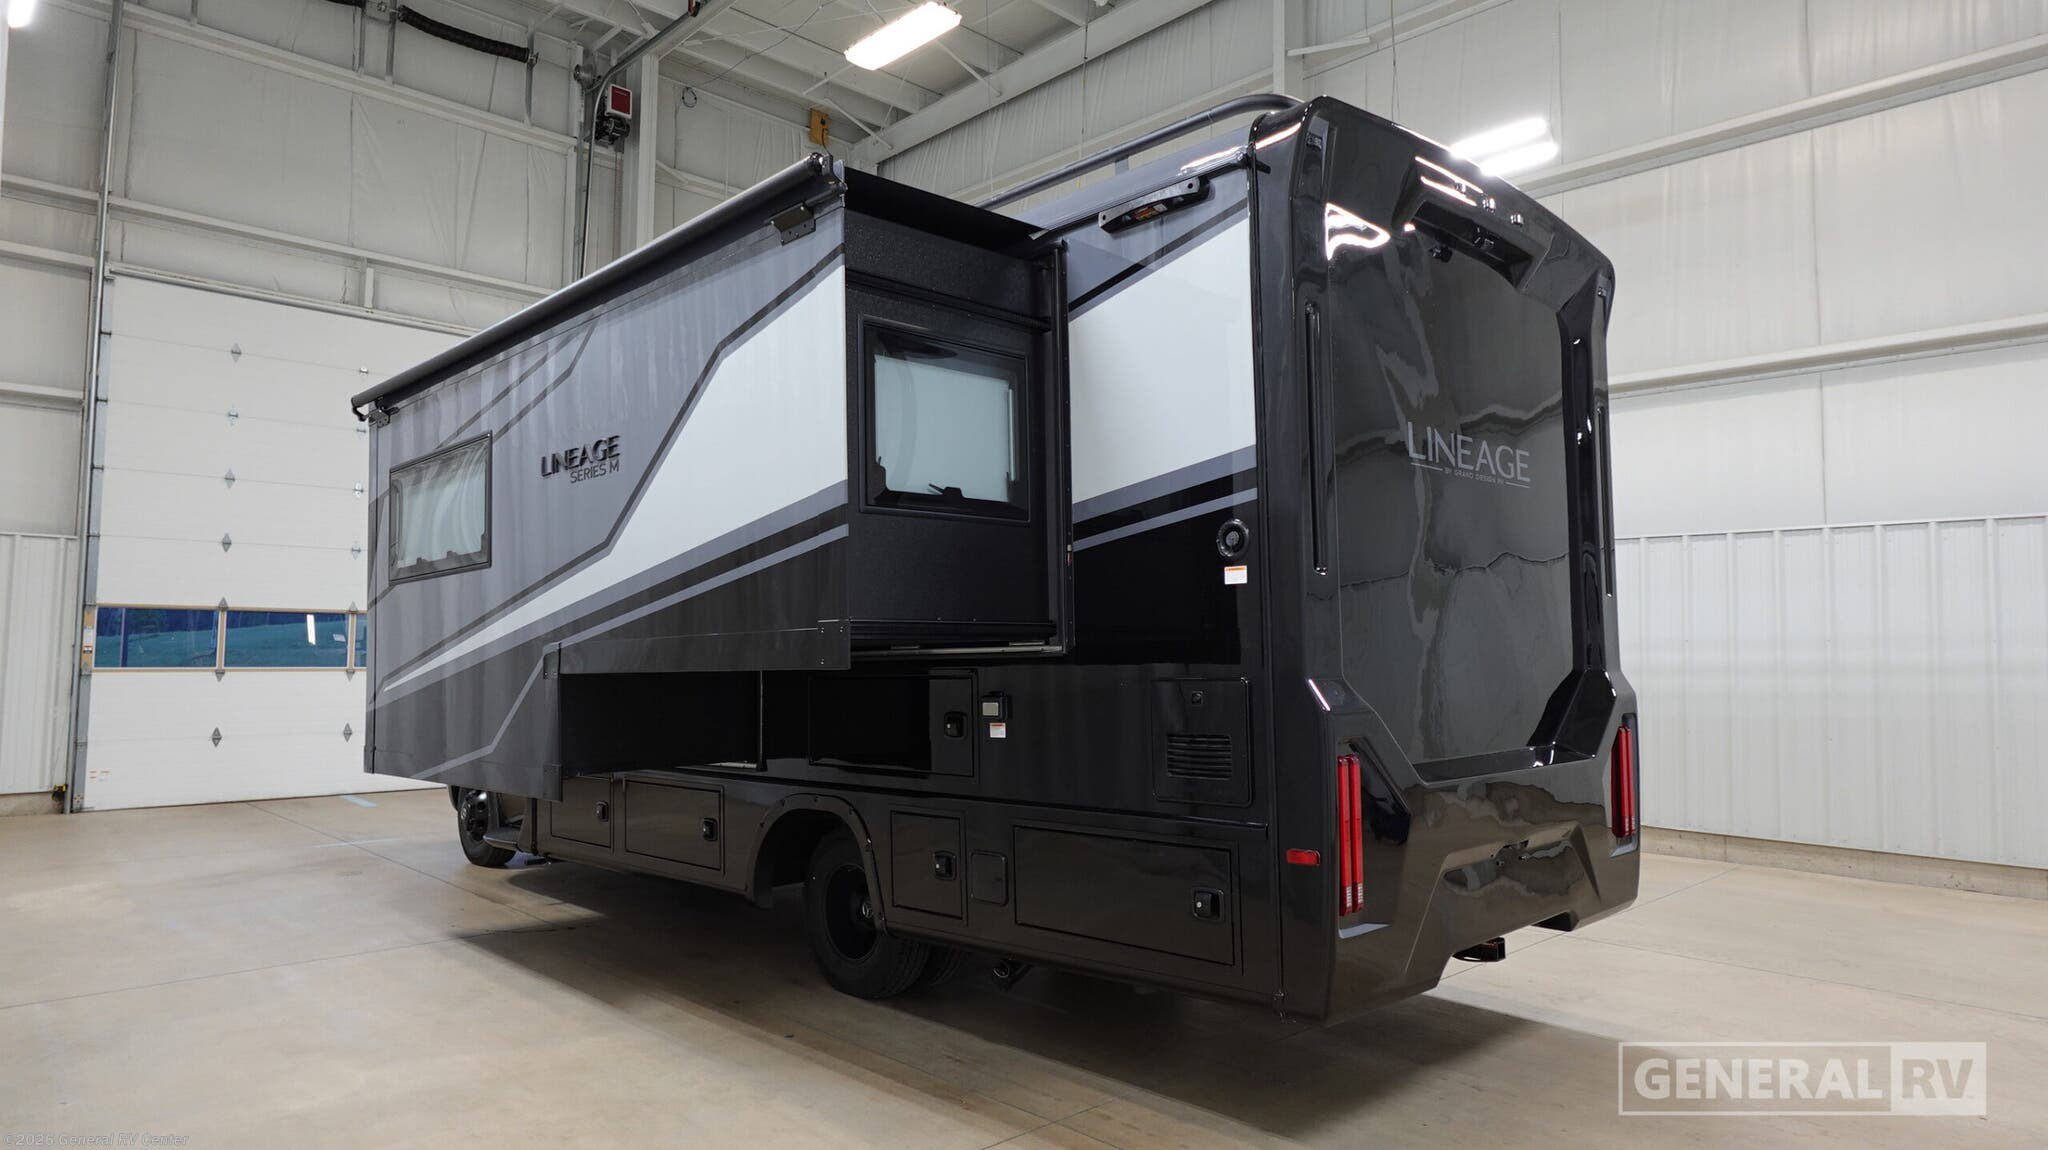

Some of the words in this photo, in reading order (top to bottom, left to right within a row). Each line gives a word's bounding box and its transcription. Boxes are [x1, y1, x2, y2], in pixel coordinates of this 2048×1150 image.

[540, 435, 621, 477] LINEAGE
[570, 463, 607, 484] SERIES
[608, 458, 620, 474] M
[1407, 421, 1531, 482] LINEAGE
